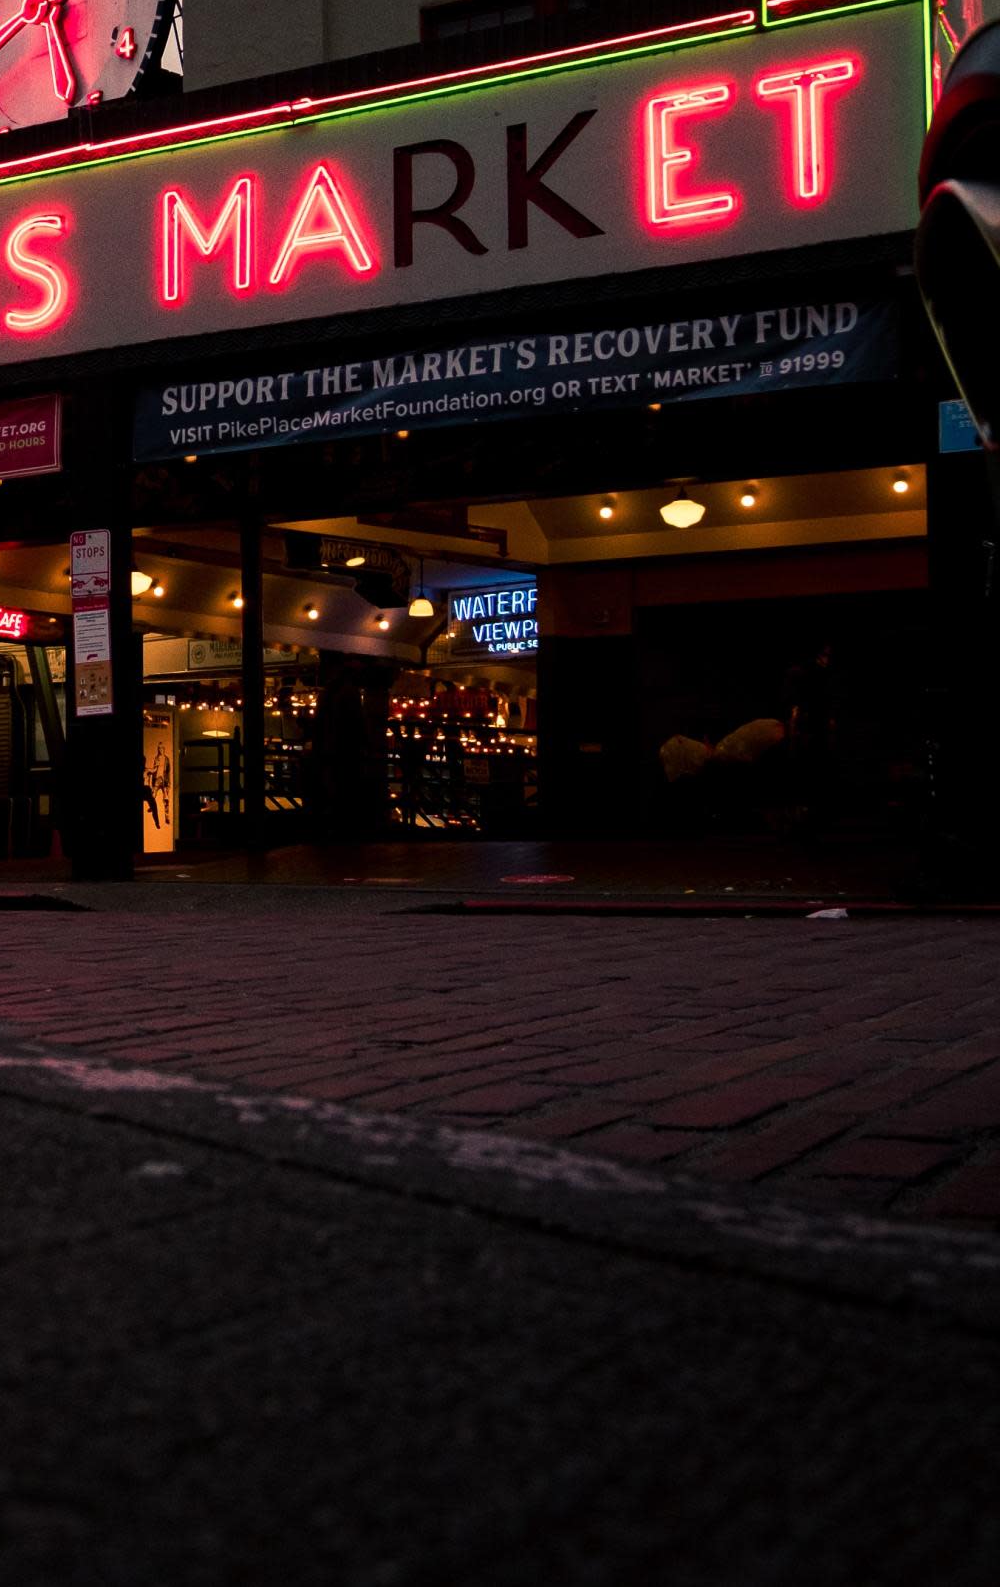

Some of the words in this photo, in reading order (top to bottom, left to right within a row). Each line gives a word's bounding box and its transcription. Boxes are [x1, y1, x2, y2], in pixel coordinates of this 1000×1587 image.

[116, 27, 137, 60] 4
[161, 58, 857, 304] MARKET
[160, 371, 297, 416] SUPPORT
[302, 361, 363, 399] THE
[371, 338, 537, 391] MARKET'S
[547, 313, 745, 368] RECOVERY
[754, 301, 859, 345] FUND
[169, 423, 214, 446] VISIT
[218, 385, 546, 440] PikePlaceMarketFoundation.org
[551, 378, 581, 399] OR
[587, 372, 641, 396] TEXT
[760, 362, 774, 376] TO
[779, 350, 845, 375] 91999
[9, 435, 46, 450] HOURS
[73, 535, 84, 544] NO
[76, 546, 105, 559] STOPS
[496, 641, 526, 651] PUBLIC
